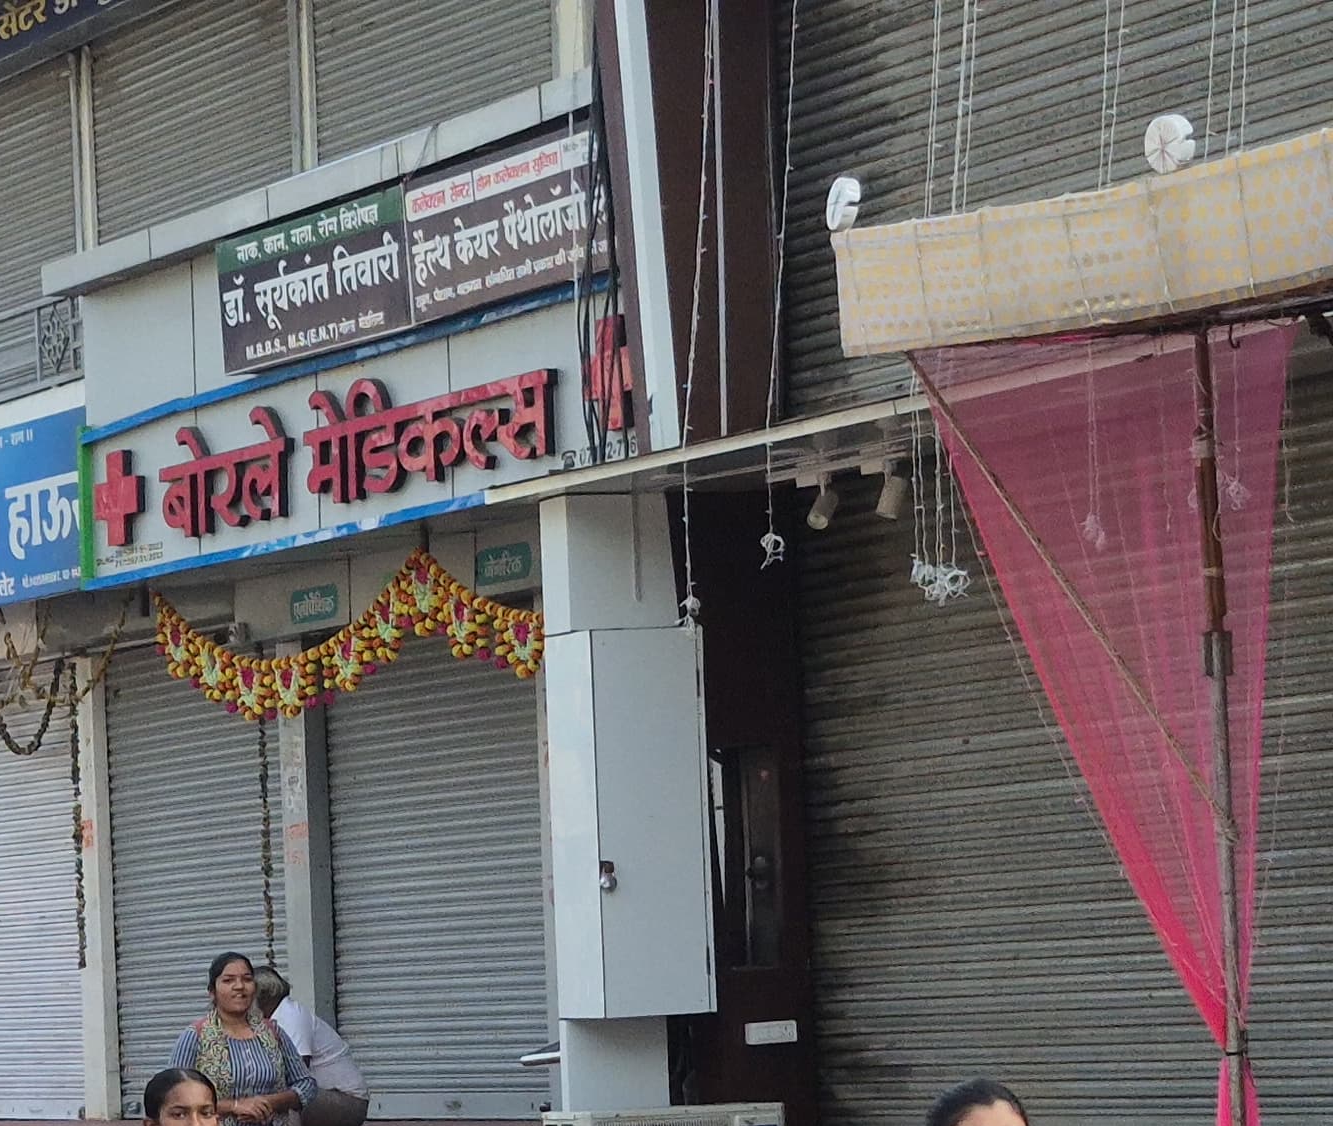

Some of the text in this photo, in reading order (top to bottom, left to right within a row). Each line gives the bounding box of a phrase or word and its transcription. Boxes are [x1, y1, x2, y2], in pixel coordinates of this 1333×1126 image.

[223, 274, 250, 327] डॉ.
[333, 231, 399, 296] तिवारी
[454, 216, 501, 265] केयर
[159, 367, 557, 538] बोरले मेडिकल्स
